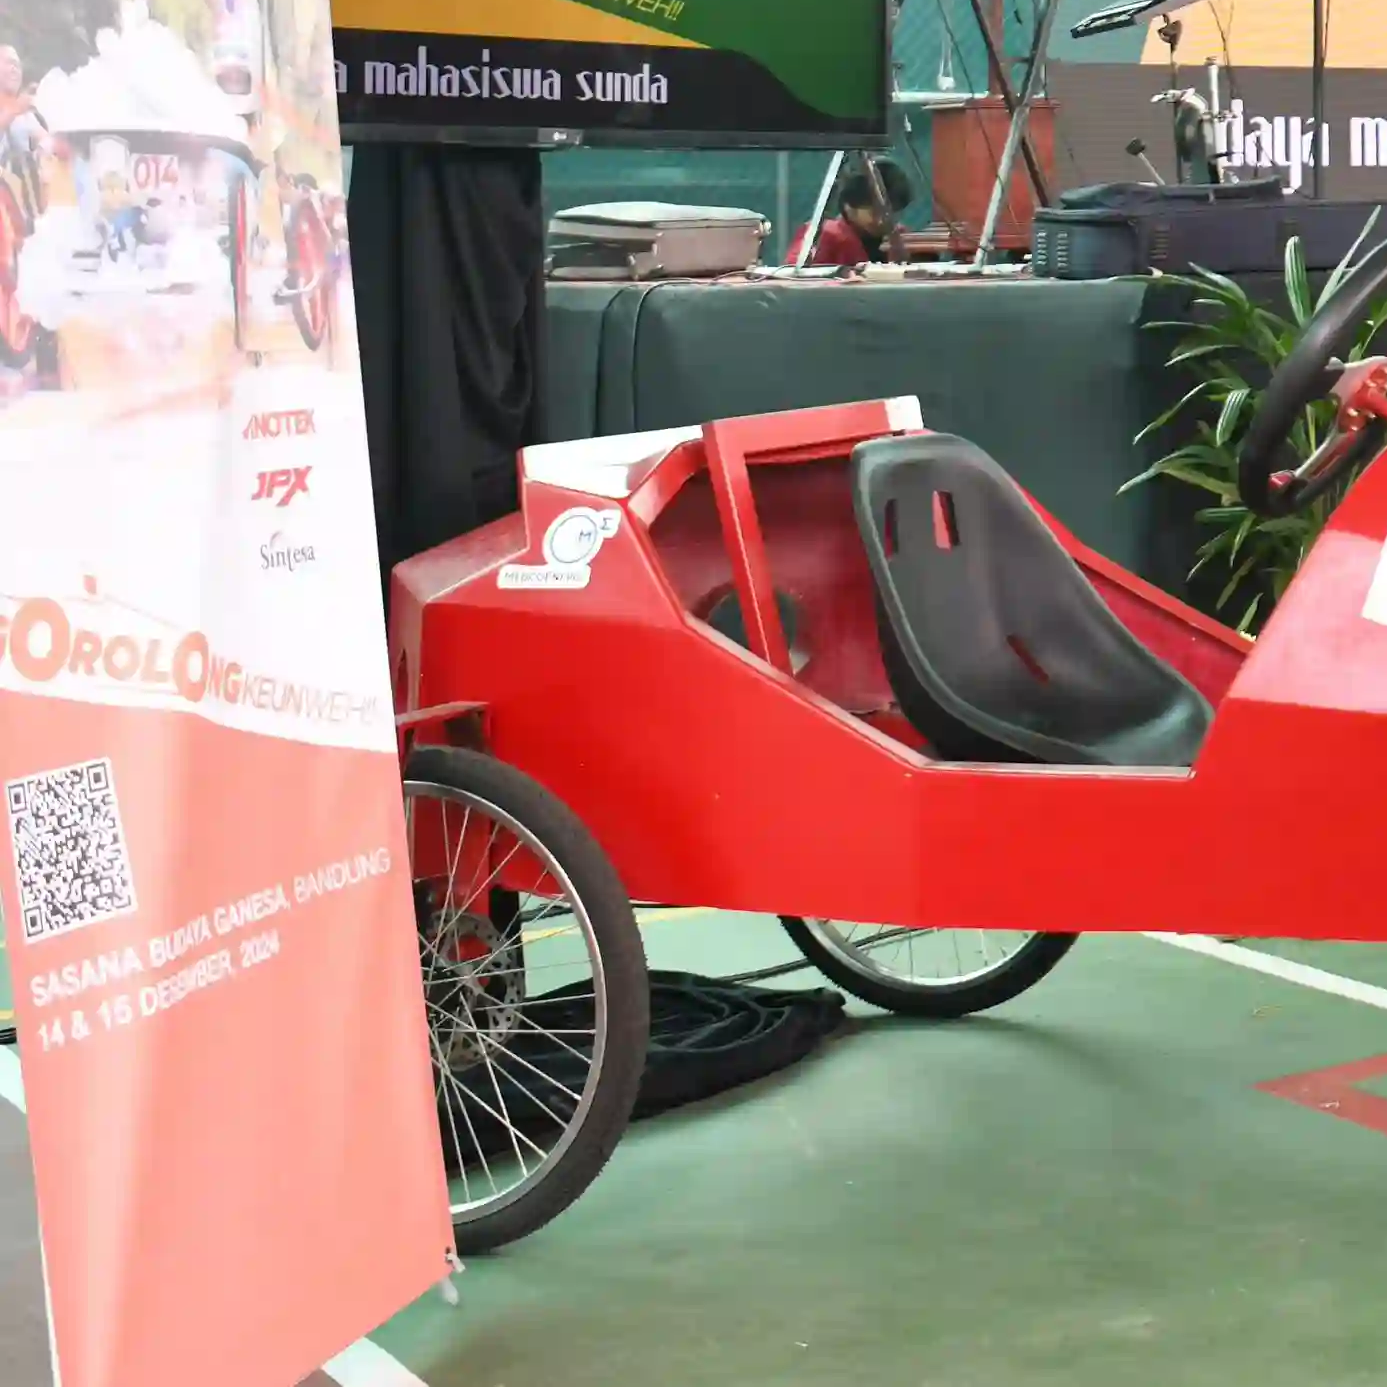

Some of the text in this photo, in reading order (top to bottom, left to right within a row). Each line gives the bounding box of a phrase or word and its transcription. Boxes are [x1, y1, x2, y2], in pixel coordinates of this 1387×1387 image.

[364, 45, 562, 99] mahasiswa
[575, 63, 668, 105] sunda
[250, 465, 313, 508] JPX
[30, 947, 144, 1008] SASANA
[149, 915, 213, 969] BUDAYA
[293, 847, 391, 903] BANDUNG
[38, 1019, 66, 1052] 14
[71, 1010, 92, 1041] &
[240, 929, 281, 969] 2024
